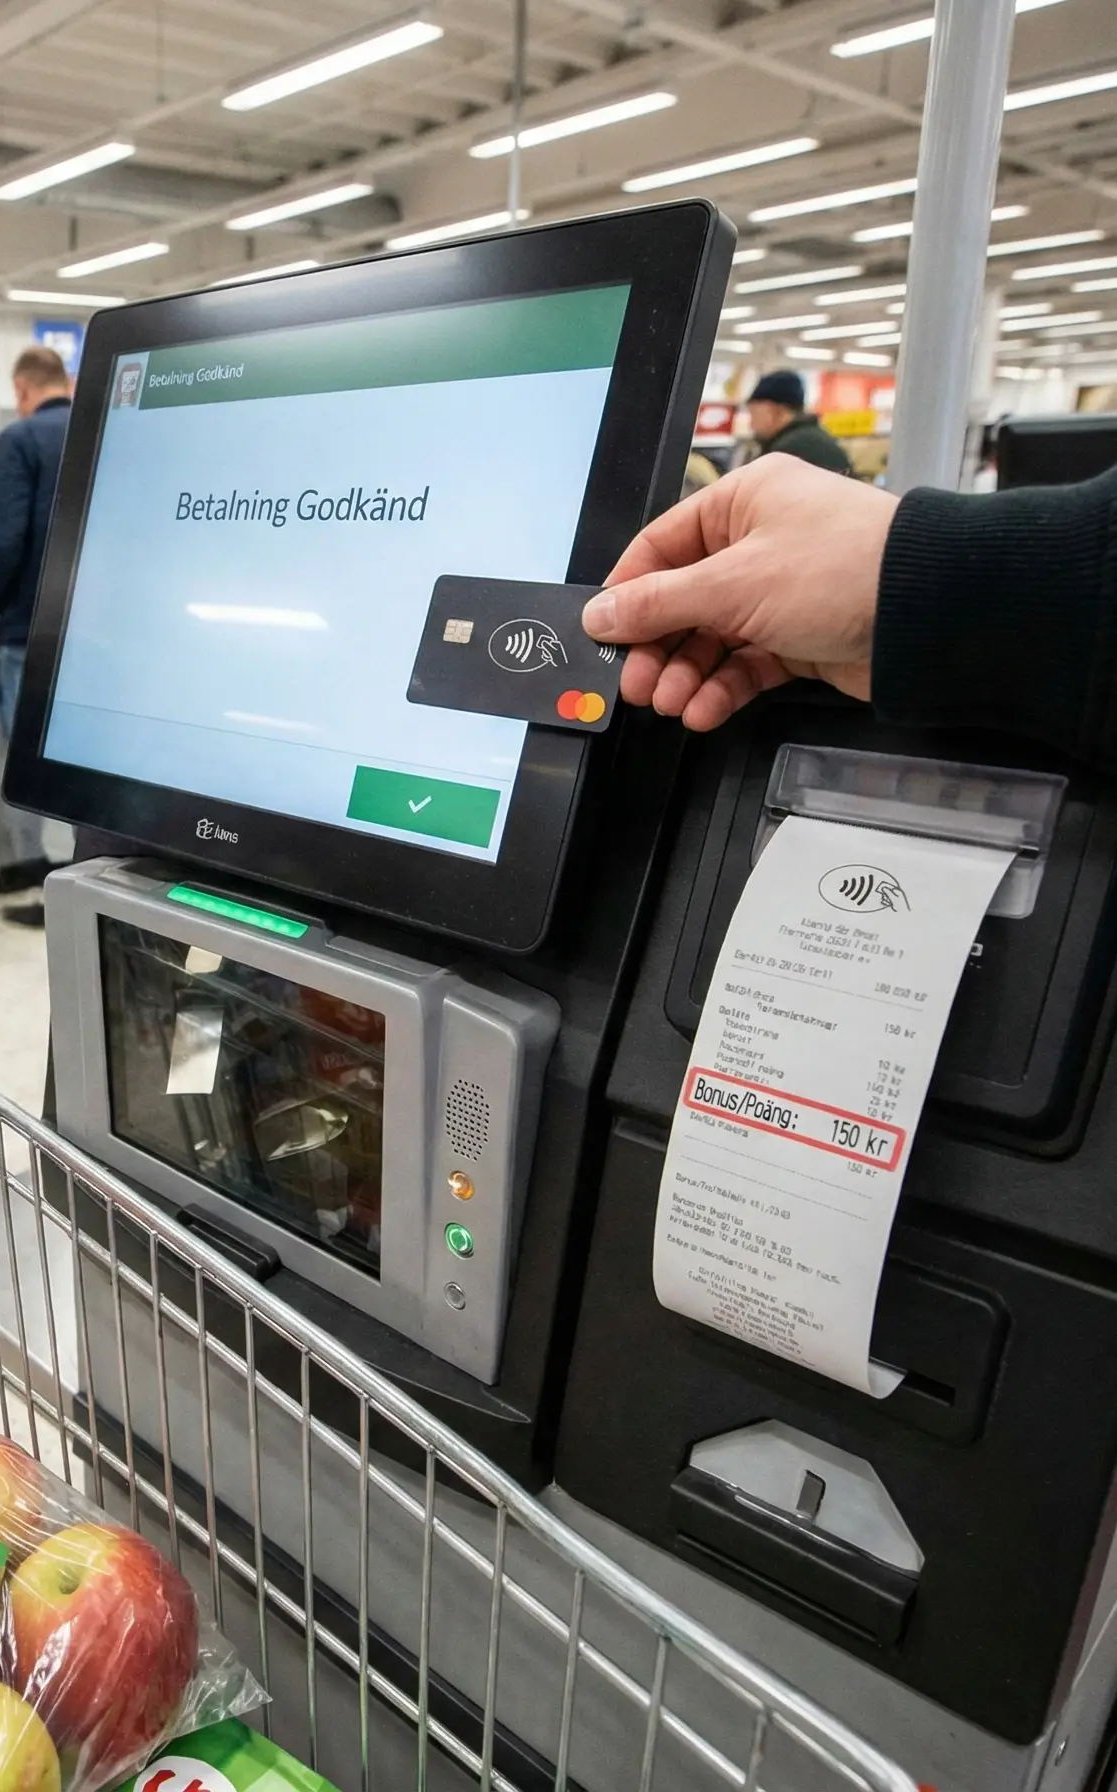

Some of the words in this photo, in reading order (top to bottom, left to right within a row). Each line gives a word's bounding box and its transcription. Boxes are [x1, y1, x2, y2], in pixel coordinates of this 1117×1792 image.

[175, 489, 291, 528] Betalning
[296, 486, 430, 521] Godkänd
[693, 1077, 799, 1130] Bonus/Poäng:
[831, 1118, 861, 1149] 150
[864, 1128, 889, 1157] kr
